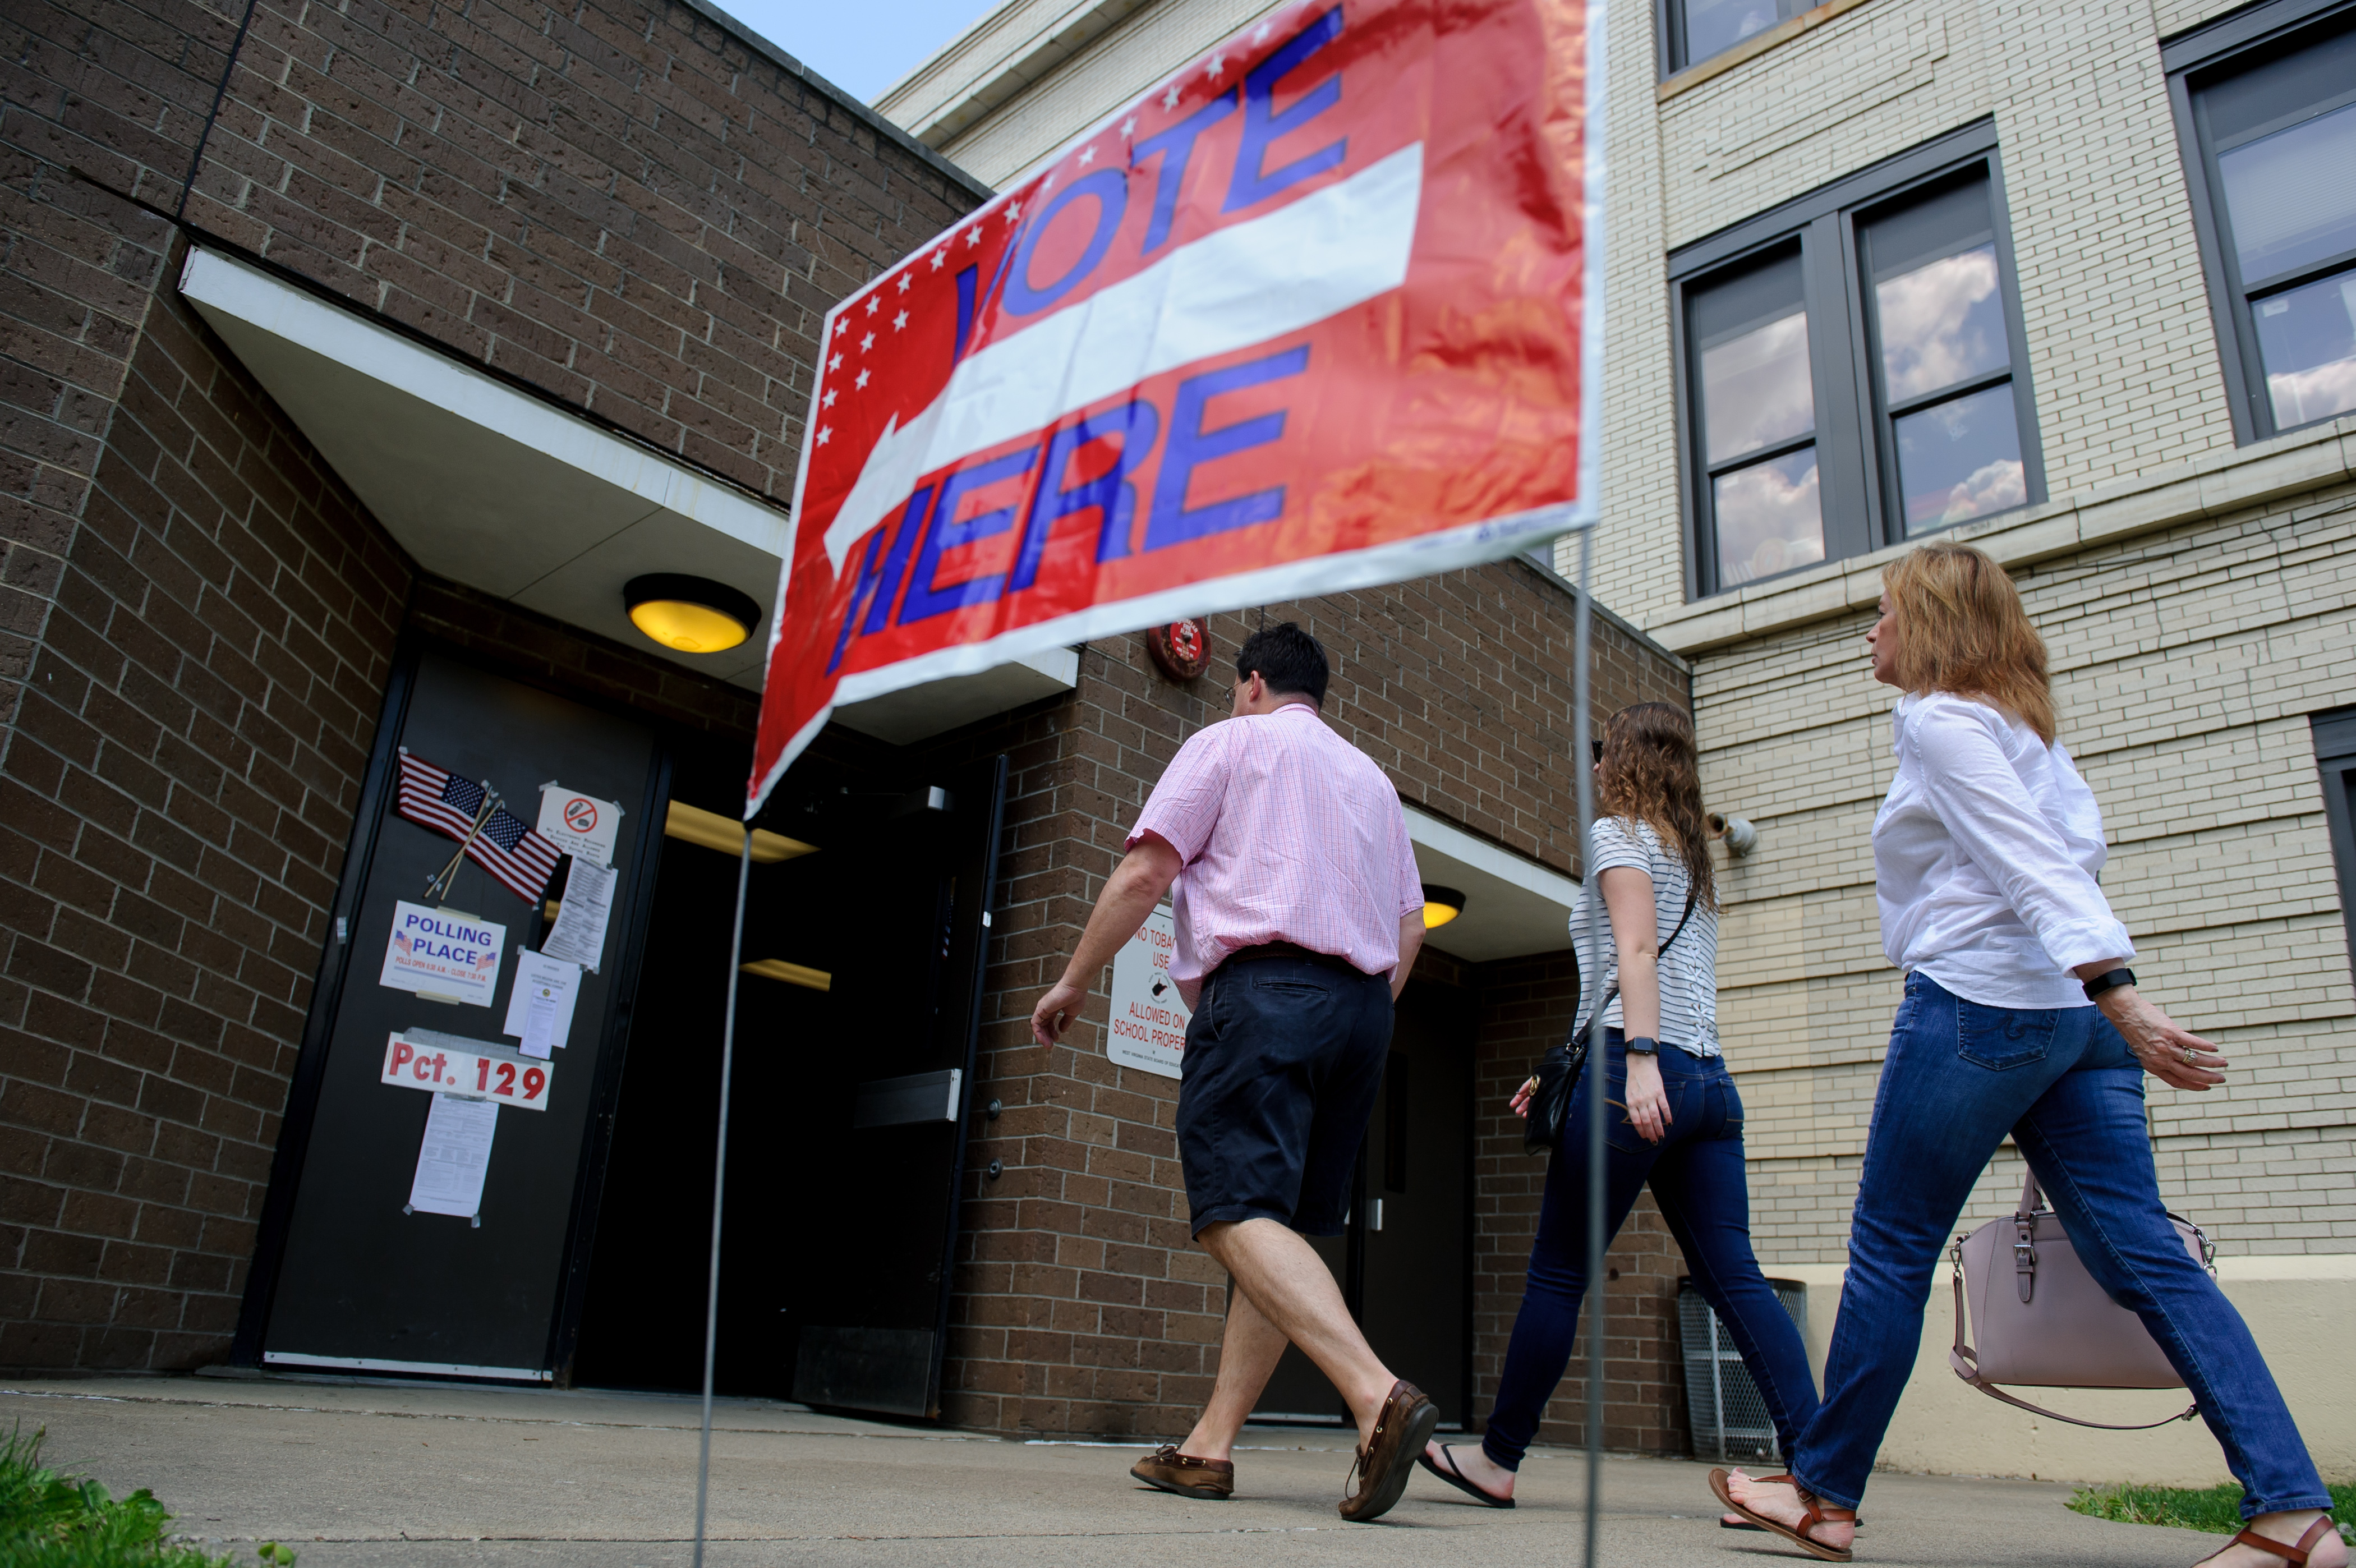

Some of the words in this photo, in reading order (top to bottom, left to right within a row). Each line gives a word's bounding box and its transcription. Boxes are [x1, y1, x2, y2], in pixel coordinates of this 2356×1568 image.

[953, 3, 1349, 368] VOTE
[825, 342, 1311, 677] HERE
[406, 914, 492, 946] POLLING
[1135, 927, 1147, 941] NO
[412, 937, 478, 965] PLACE
[1153, 951, 1170, 970] USE
[395, 955, 411, 966] POLLS
[412, 959, 426, 969] OPEN
[450, 968, 466, 978] CLOSE
[1129, 1001, 1170, 1026] ALLOWED
[1173, 1013, 1185, 1030] ON
[1114, 1019, 1148, 1042] SCHOOL
[389, 1042, 455, 1086] Pct.
[477, 1057, 545, 1101] 129
